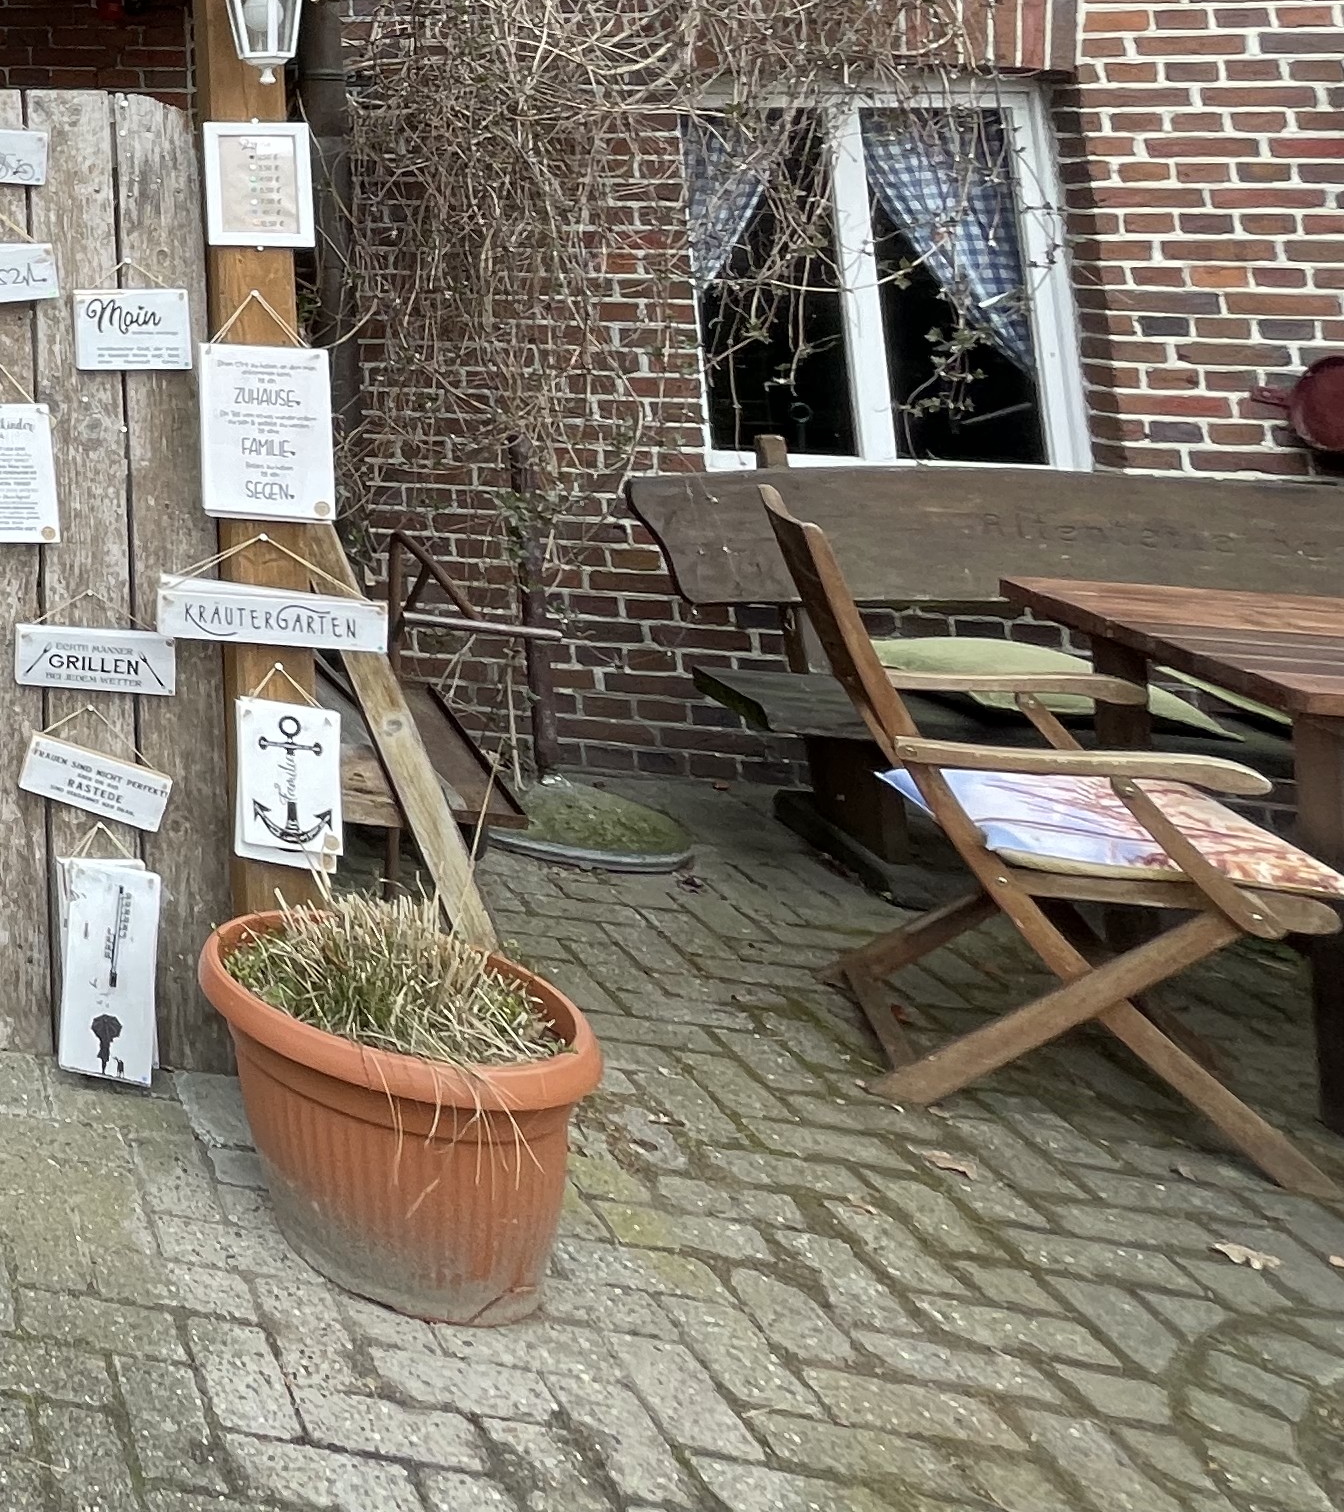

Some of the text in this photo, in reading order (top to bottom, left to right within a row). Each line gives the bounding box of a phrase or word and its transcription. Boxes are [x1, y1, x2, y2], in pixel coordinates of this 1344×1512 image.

[86, 298, 162, 335] Moin
[184, 601, 357, 639] KRÄUTERGARTEN
[48, 653, 140, 676] GRILLEN
[100, 676, 142, 687] WETTER
[33, 749, 68, 766] FRAUEN
[71, 760, 93, 773] SIND
[96, 769, 123, 784] NICHT
[67, 778, 124, 804] RASTEDE
